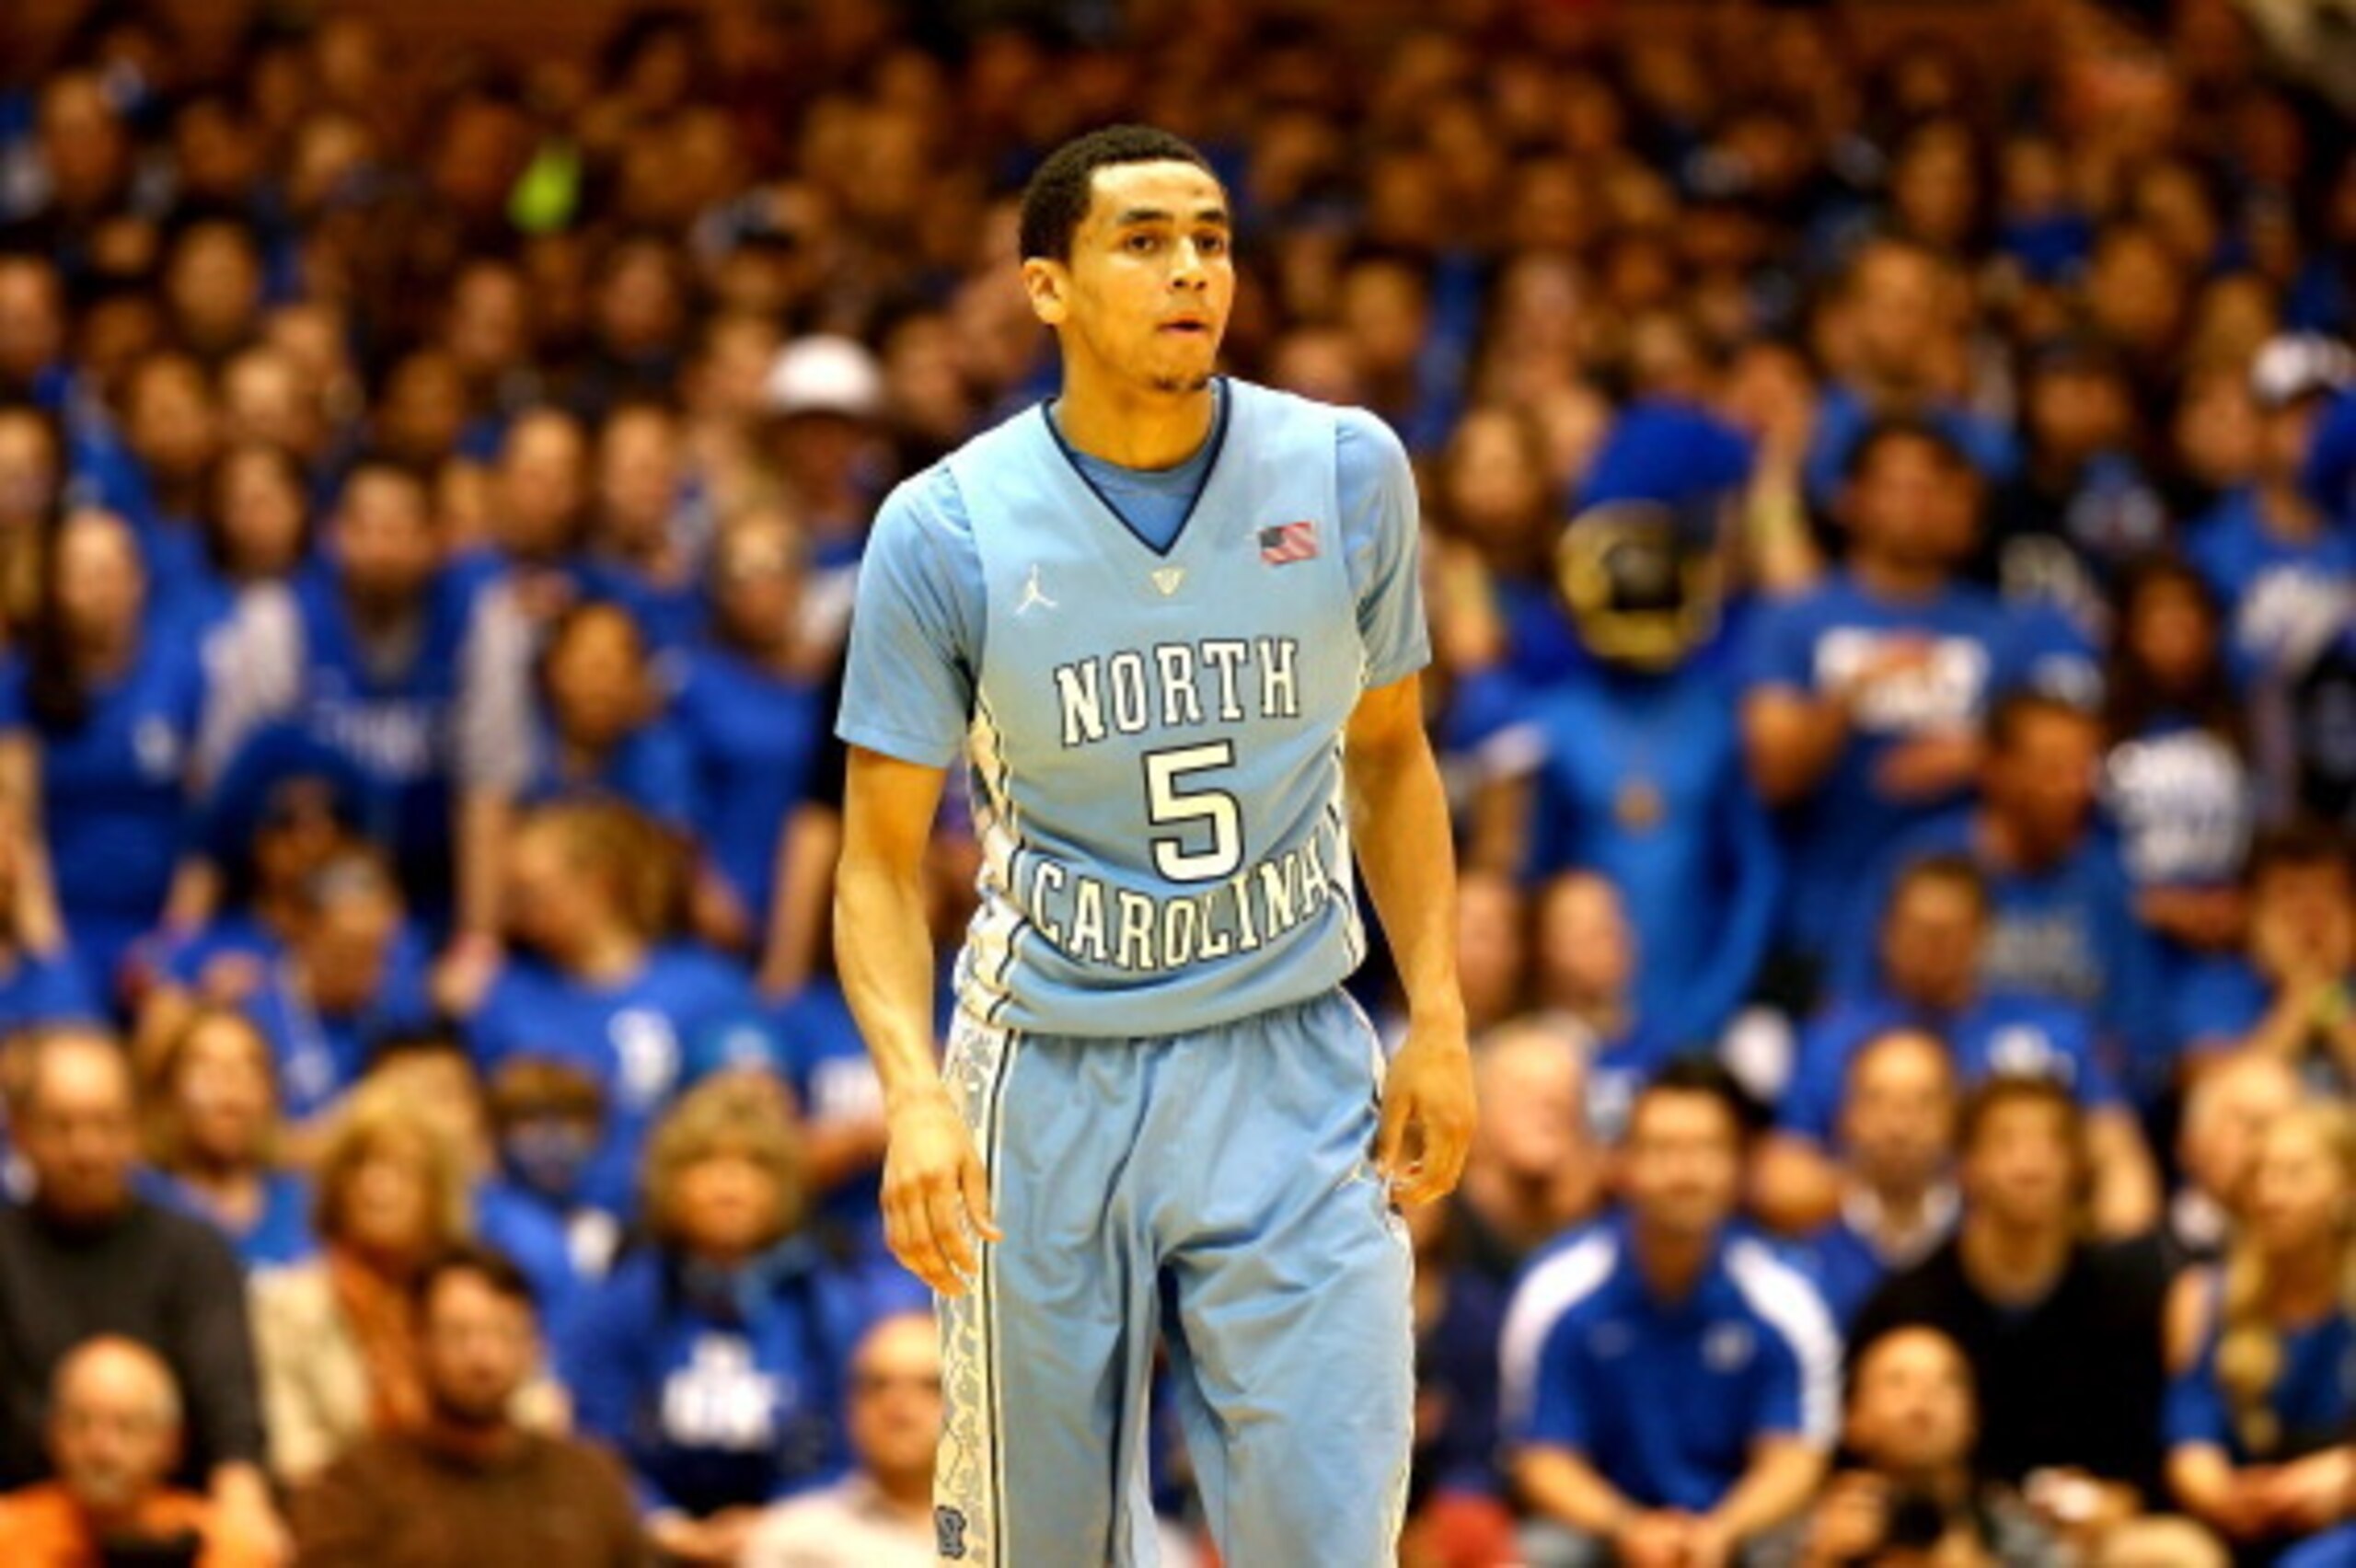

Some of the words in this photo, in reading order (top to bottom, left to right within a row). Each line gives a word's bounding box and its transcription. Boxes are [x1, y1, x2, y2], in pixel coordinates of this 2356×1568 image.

[1056, 639, 1299, 747] NORTH
[1141, 740, 1244, 883] 5
[1031, 836, 1331, 970] CAROLINA
